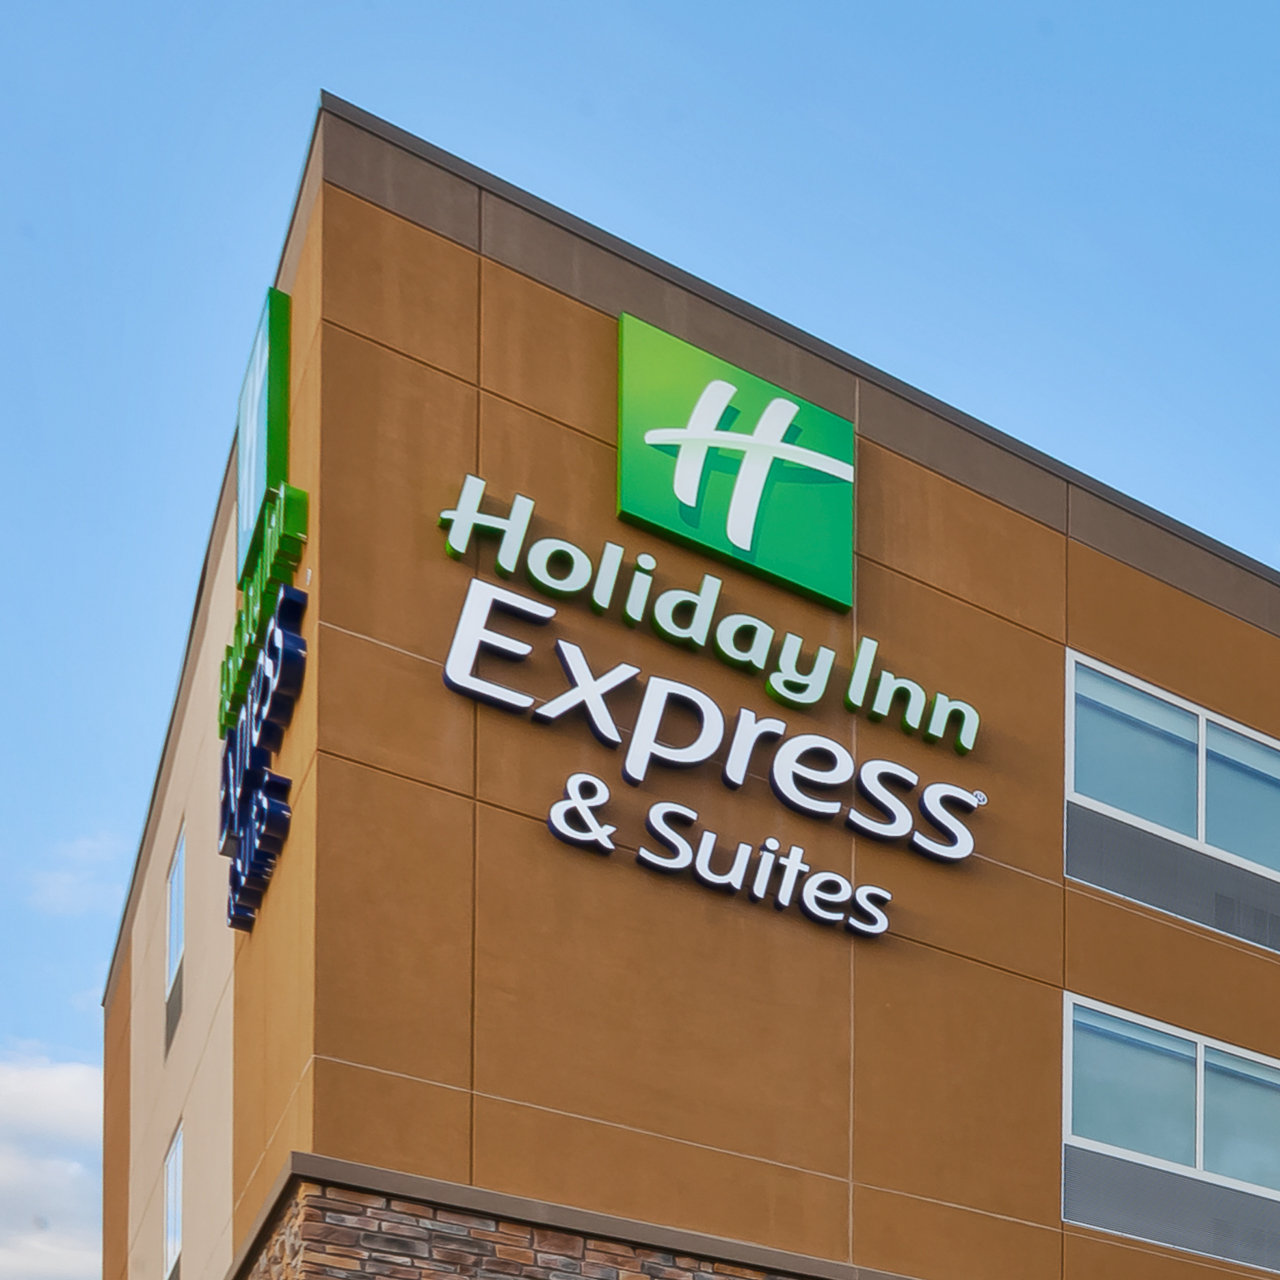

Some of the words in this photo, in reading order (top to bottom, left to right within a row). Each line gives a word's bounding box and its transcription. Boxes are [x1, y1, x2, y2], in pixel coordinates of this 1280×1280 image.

[438, 474, 836, 705] Holiday
[846, 636, 981, 752] Inn
[548, 772, 617, 851] &
[637, 802, 892, 935] Suites
